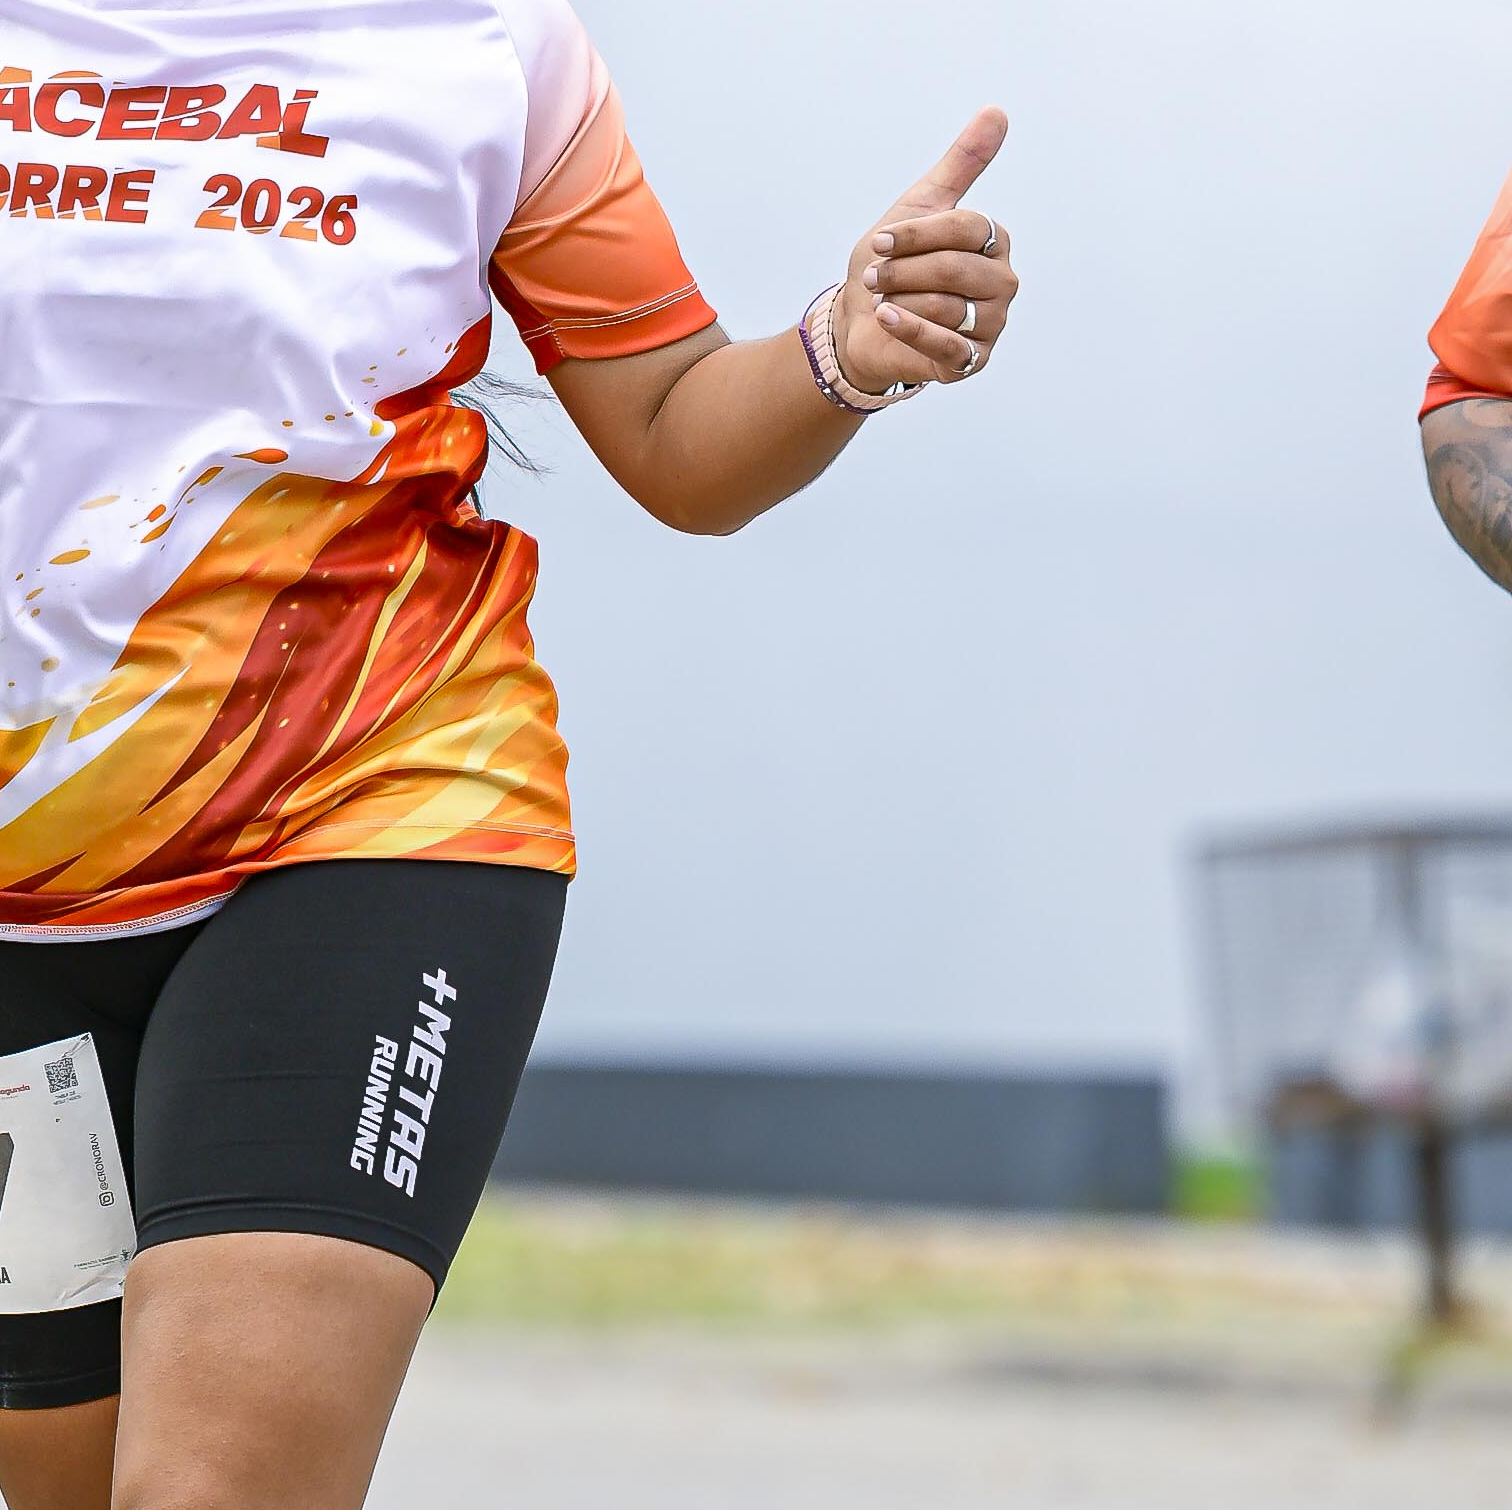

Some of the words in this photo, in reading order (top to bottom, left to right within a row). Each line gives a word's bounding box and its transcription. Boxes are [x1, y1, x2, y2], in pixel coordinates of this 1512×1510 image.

[194, 173, 358, 245] 2026
[350, 1035, 399, 1175] RUNNING
[89, 1132, 109, 1190] @CRONORAV
